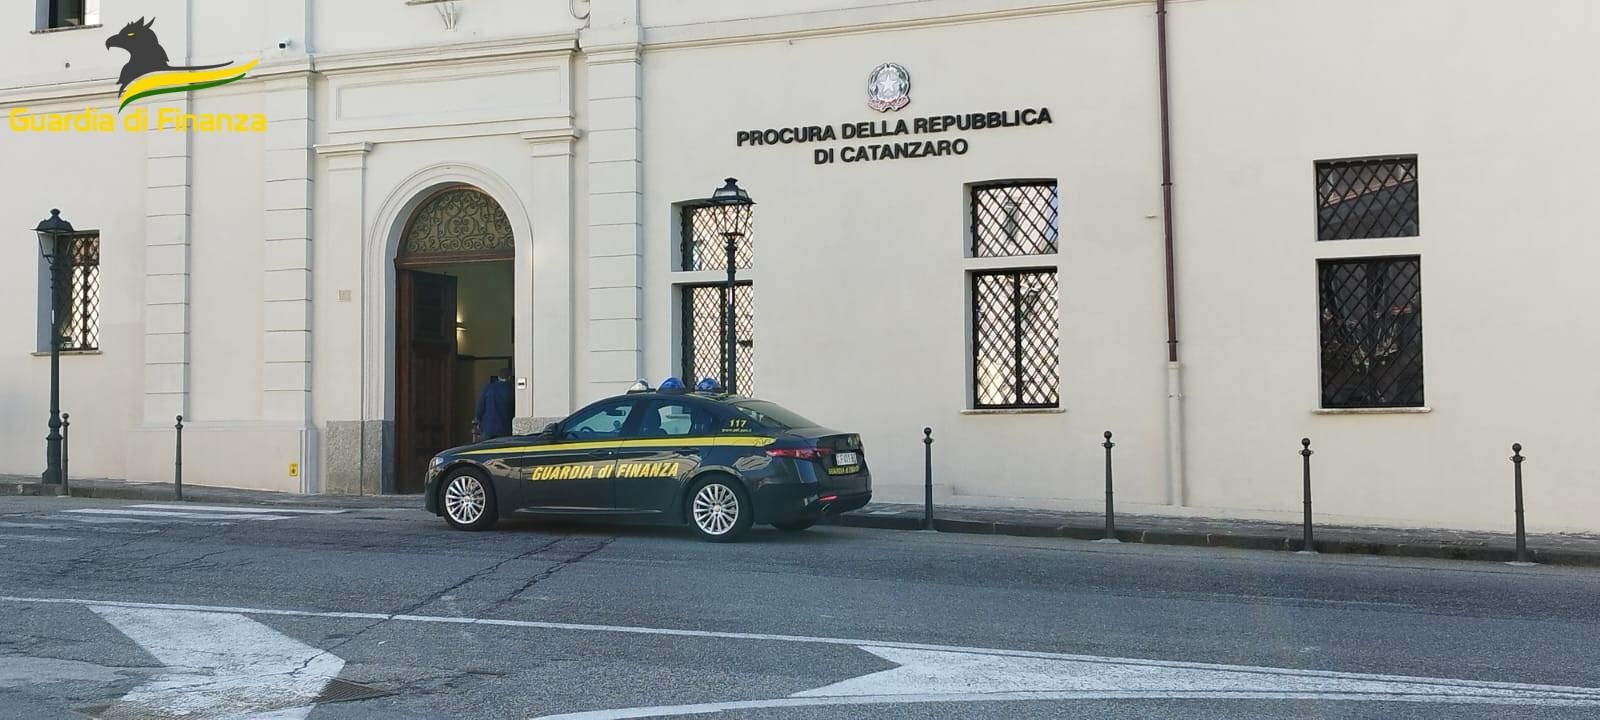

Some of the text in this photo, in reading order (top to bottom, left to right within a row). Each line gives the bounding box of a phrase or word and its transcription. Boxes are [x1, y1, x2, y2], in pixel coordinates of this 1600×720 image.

[736, 107, 1053, 146] PROCURA DELLA REPUBBLICA
[814, 138, 969, 165] DI CATANZARO
[730, 419, 747, 428] 117
[531, 462, 679, 481] GUARDIA di FINANZA
